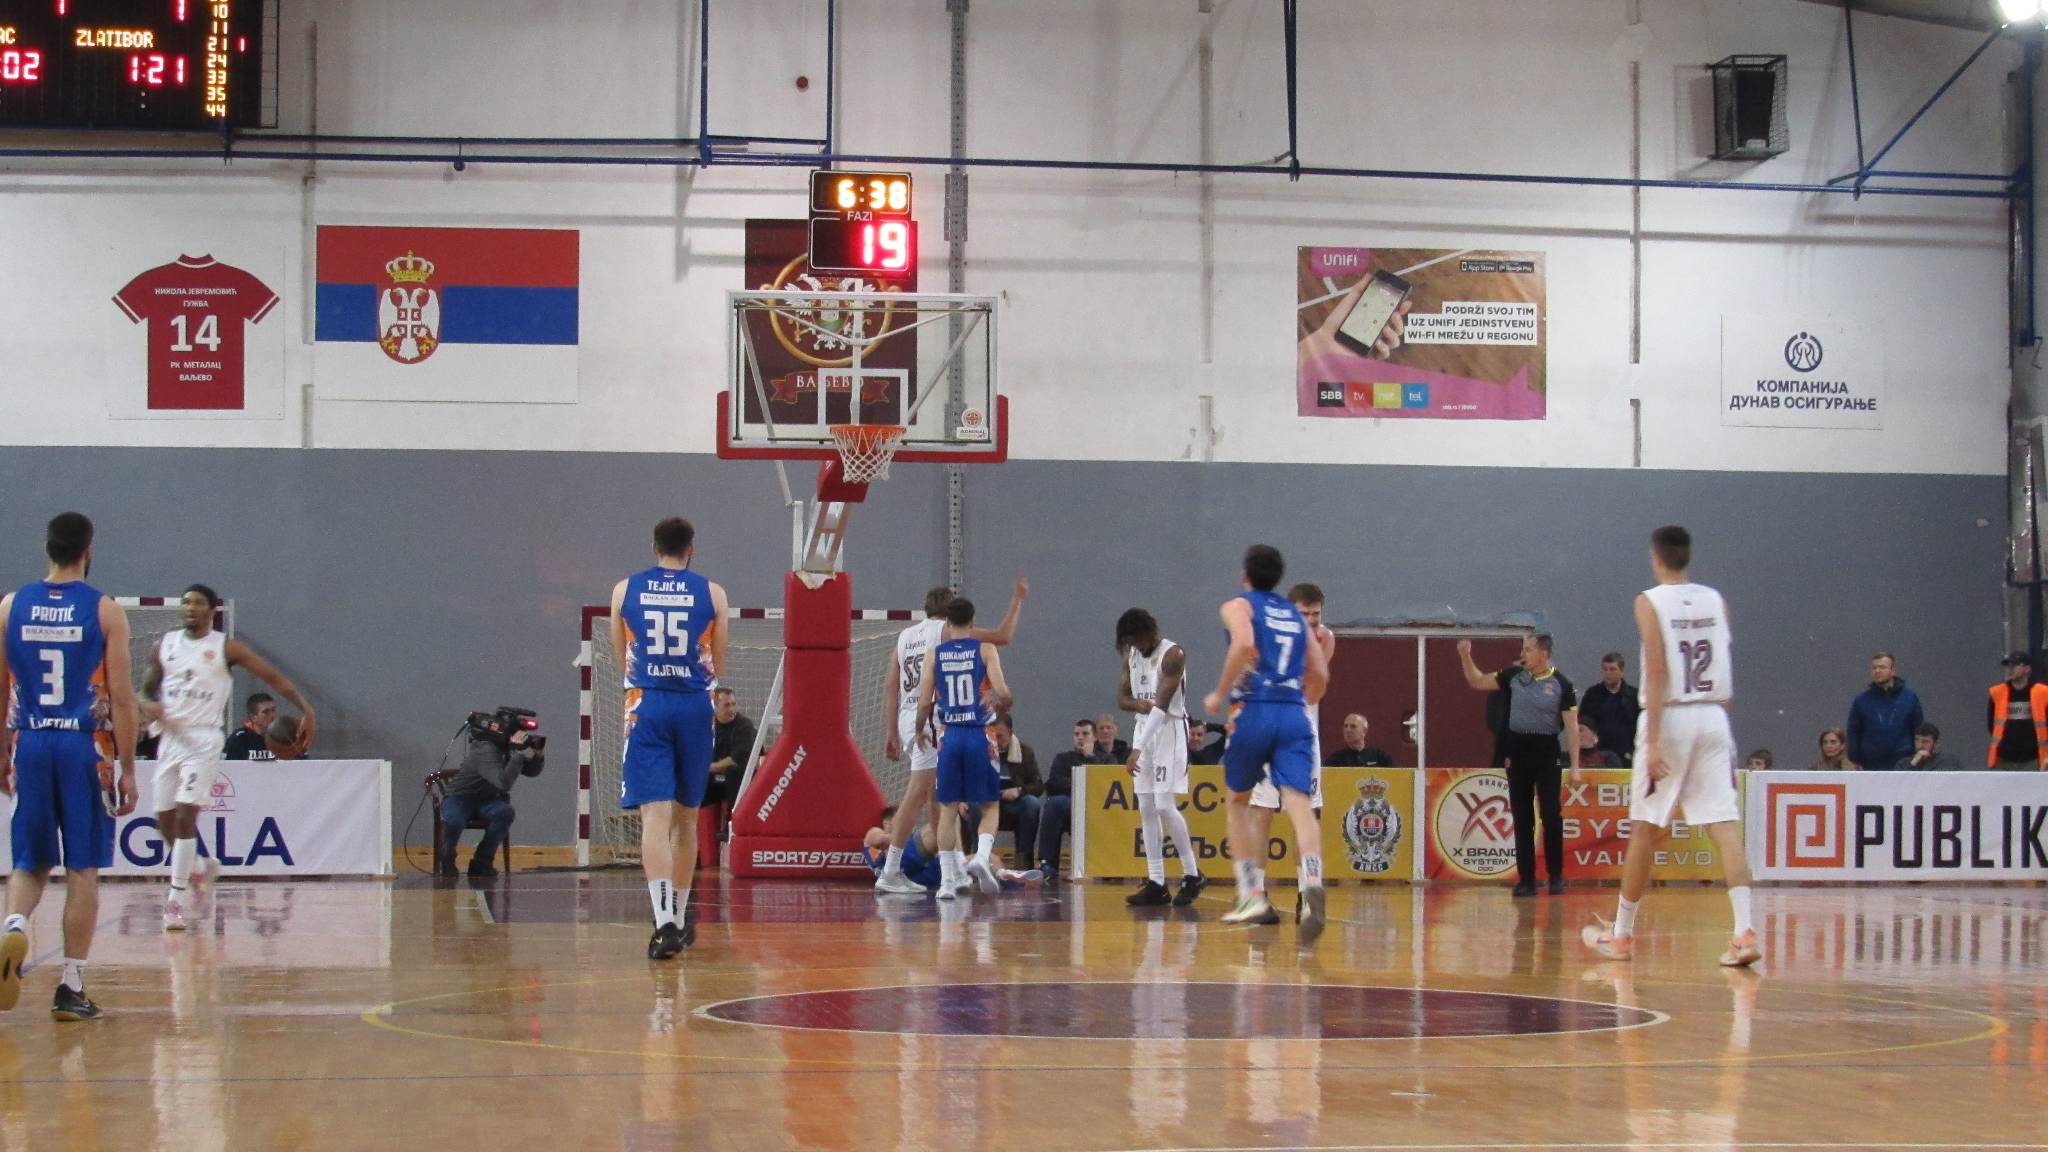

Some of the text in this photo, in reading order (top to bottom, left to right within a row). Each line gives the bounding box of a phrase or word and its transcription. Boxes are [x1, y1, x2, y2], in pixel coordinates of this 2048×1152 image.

[213, 5, 228, 19] 10
[213, 22, 228, 34] 11
[75, 29, 154, 48] ZLATIBOR
[207, 37, 228, 51] 21
[207, 53, 228, 68] 24
[207, 70, 227, 85] 33
[207, 86, 226, 101] 35
[206, 104, 226, 117] 44
[837, 179, 907, 209] 6:38
[846, 211, 873, 222] FAZI
[862, 222, 907, 268] 19
[1445, 305, 1534, 315] PODRŽI SVOJ TIM
[1411, 318, 1534, 328] UZ UNIFI JEDINSTVENU
[170, 314, 222, 352] 14
[1408, 330, 1534, 341] WI-FI MREŽU U REGIONU
[183, 362, 222, 370] МЕТАЛАЦ
[179, 374, 213, 382] ВАЉЕВО
[1756, 379, 1849, 394] КОМПАНИЈА
[1320, 391, 1343, 400] SBB
[1729, 395, 1877, 410] ДУНАВ ОСИГУРАЊЕ
[31, 604, 75, 622] PROTIĆ
[643, 610, 689, 656] 35
[1274, 634, 1295, 676] 7
[1678, 639, 1713, 693] 12
[39, 648, 65, 706] 3
[944, 673, 975, 707] 10
[757, 744, 807, 822] HYDROPLAY
[1854, 804, 2048, 869] PUBLIK
[1463, 858, 1509, 866] SYSTEM
